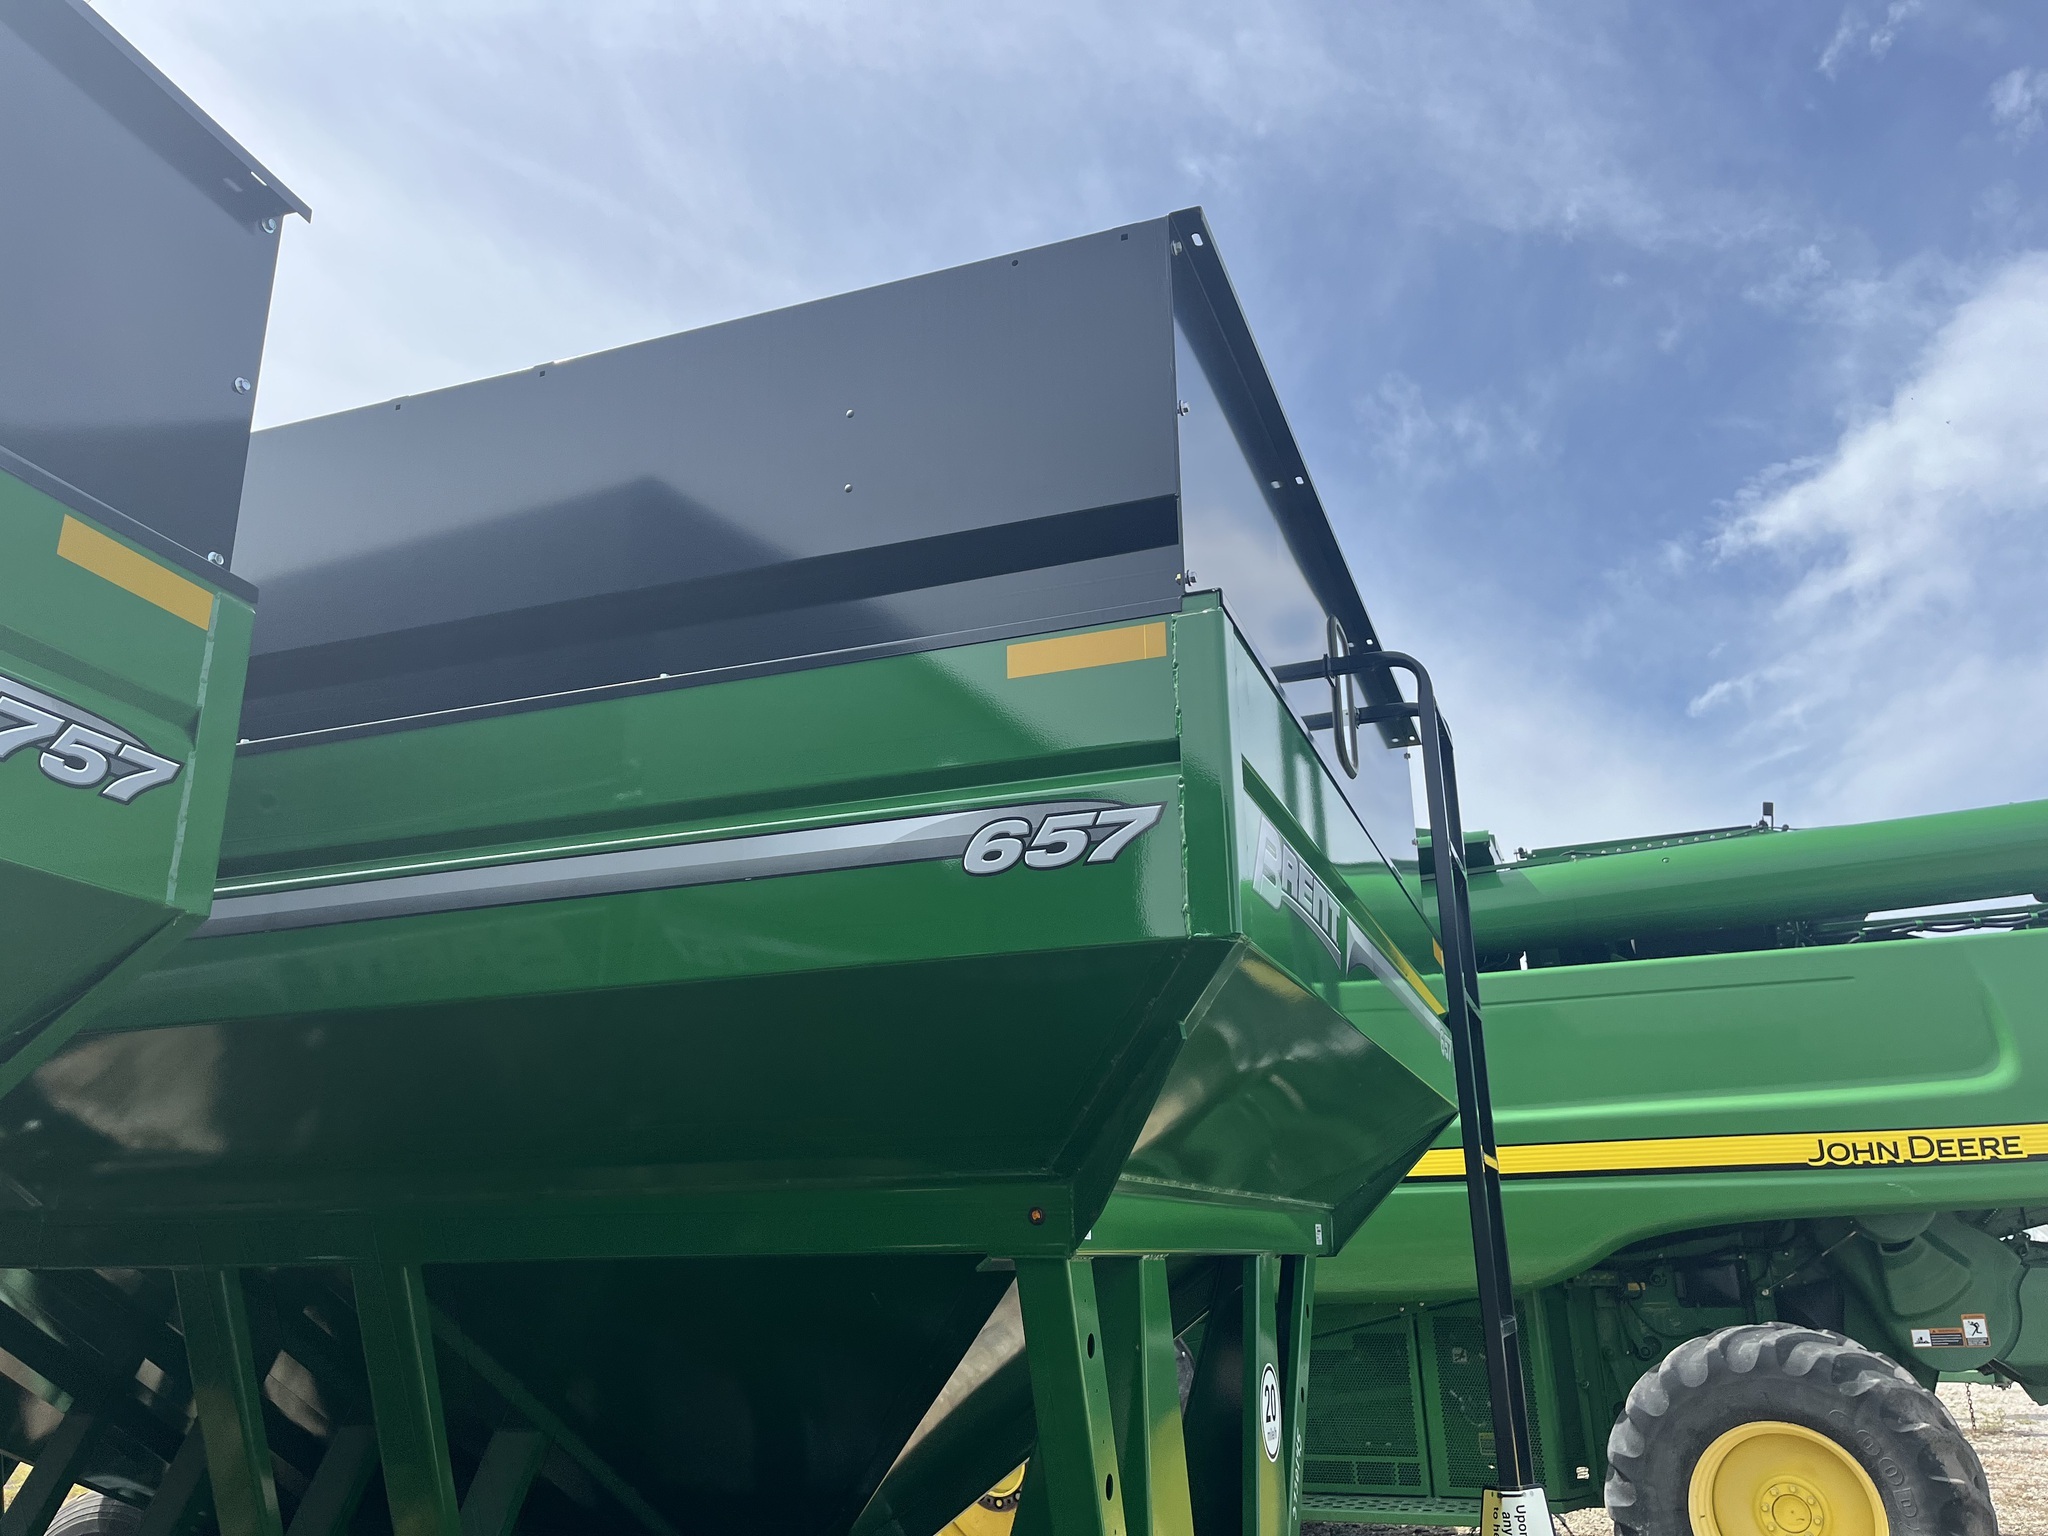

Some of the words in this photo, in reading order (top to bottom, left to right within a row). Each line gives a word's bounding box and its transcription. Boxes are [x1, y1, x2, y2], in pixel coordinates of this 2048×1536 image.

[0, 694, 184, 805] 757
[962, 801, 1167, 877] 657
[1254, 814, 1343, 955] BRENT
[1808, 1139, 1900, 1163] JOHN
[1907, 1135, 2023, 1159] DEERE
[1265, 1384, 1276, 1423] 20
